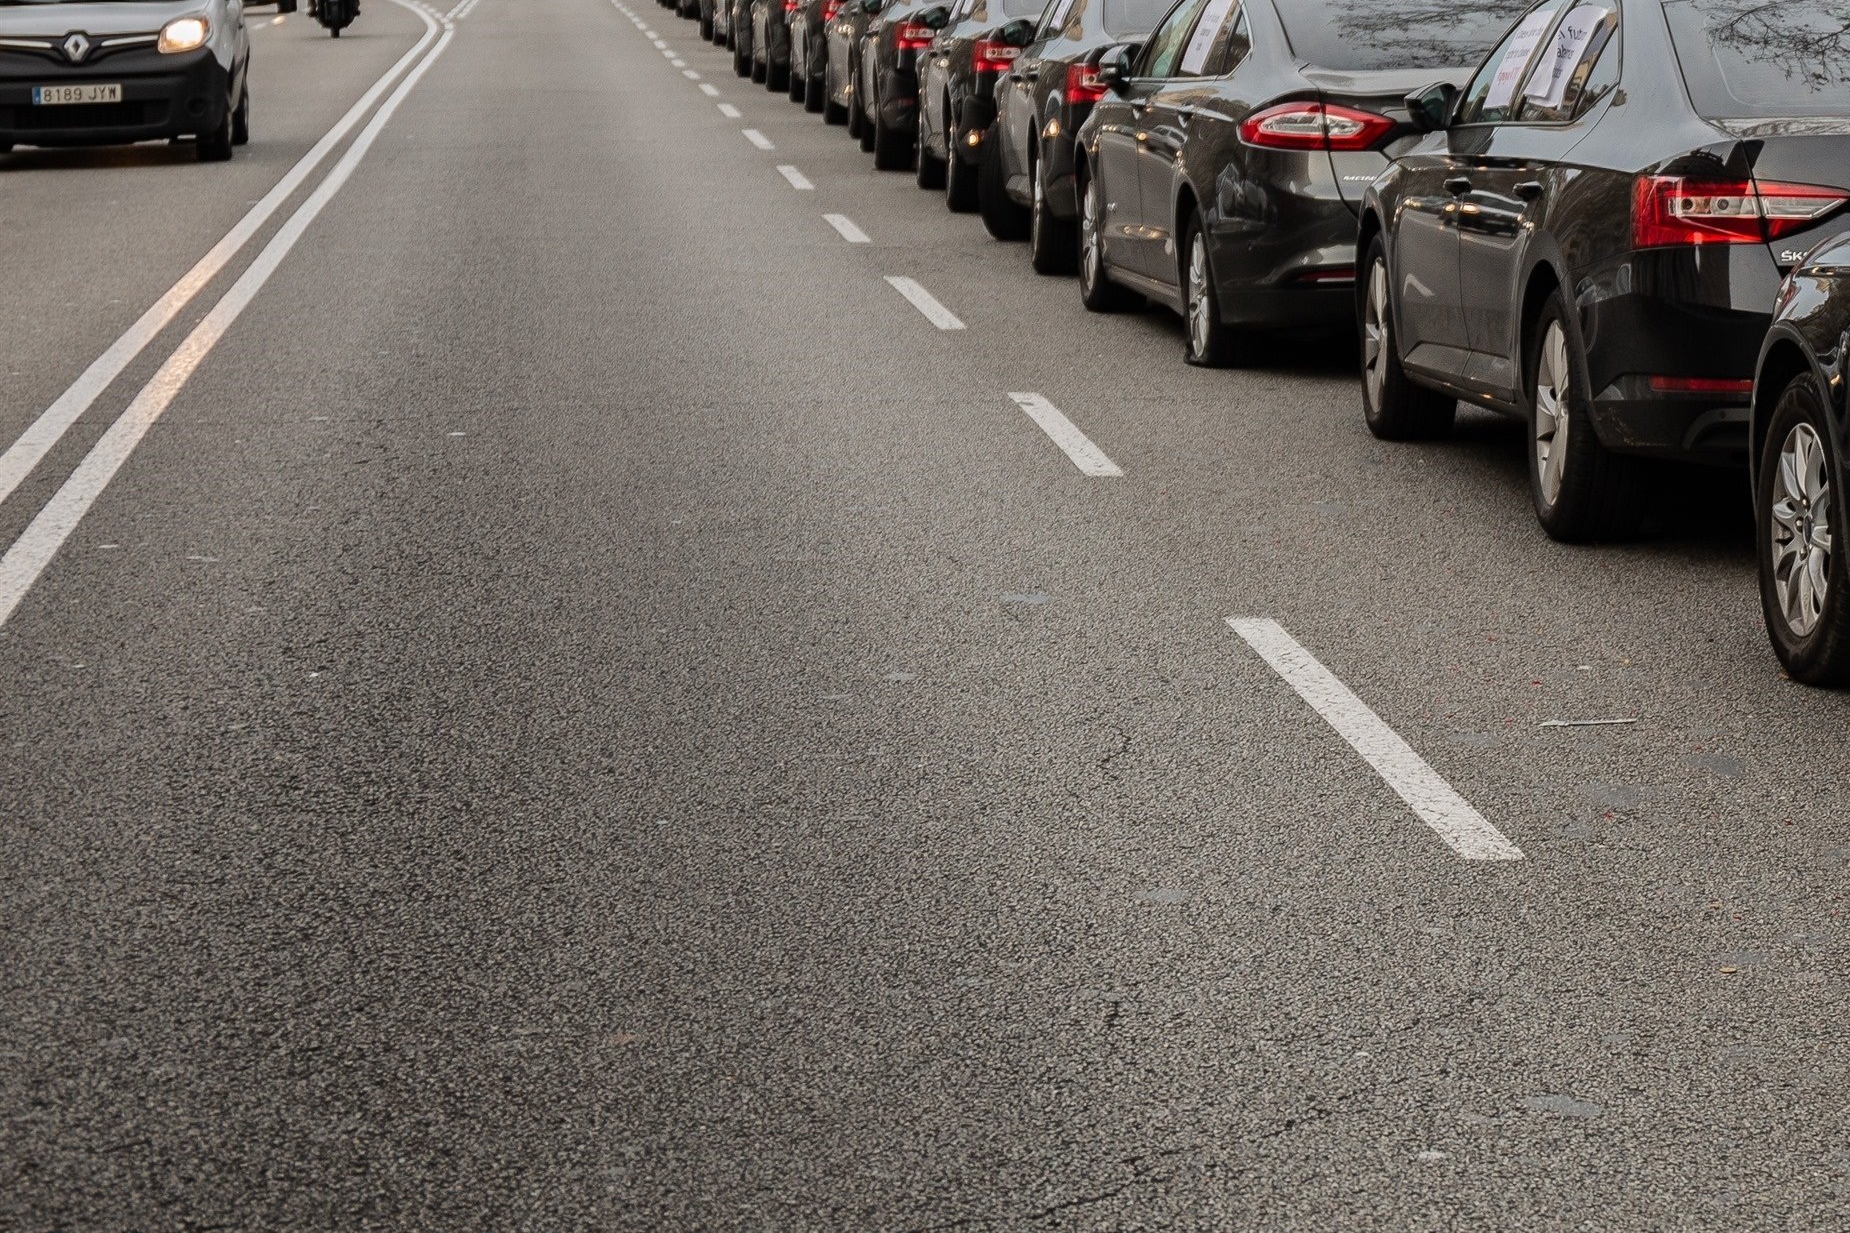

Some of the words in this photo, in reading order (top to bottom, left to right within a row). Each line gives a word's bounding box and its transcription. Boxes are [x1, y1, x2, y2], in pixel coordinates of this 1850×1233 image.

[43, 87, 82, 102] 8189
[88, 86, 117, 101] JYW
[1781, 249, 1808, 262] ŠK
